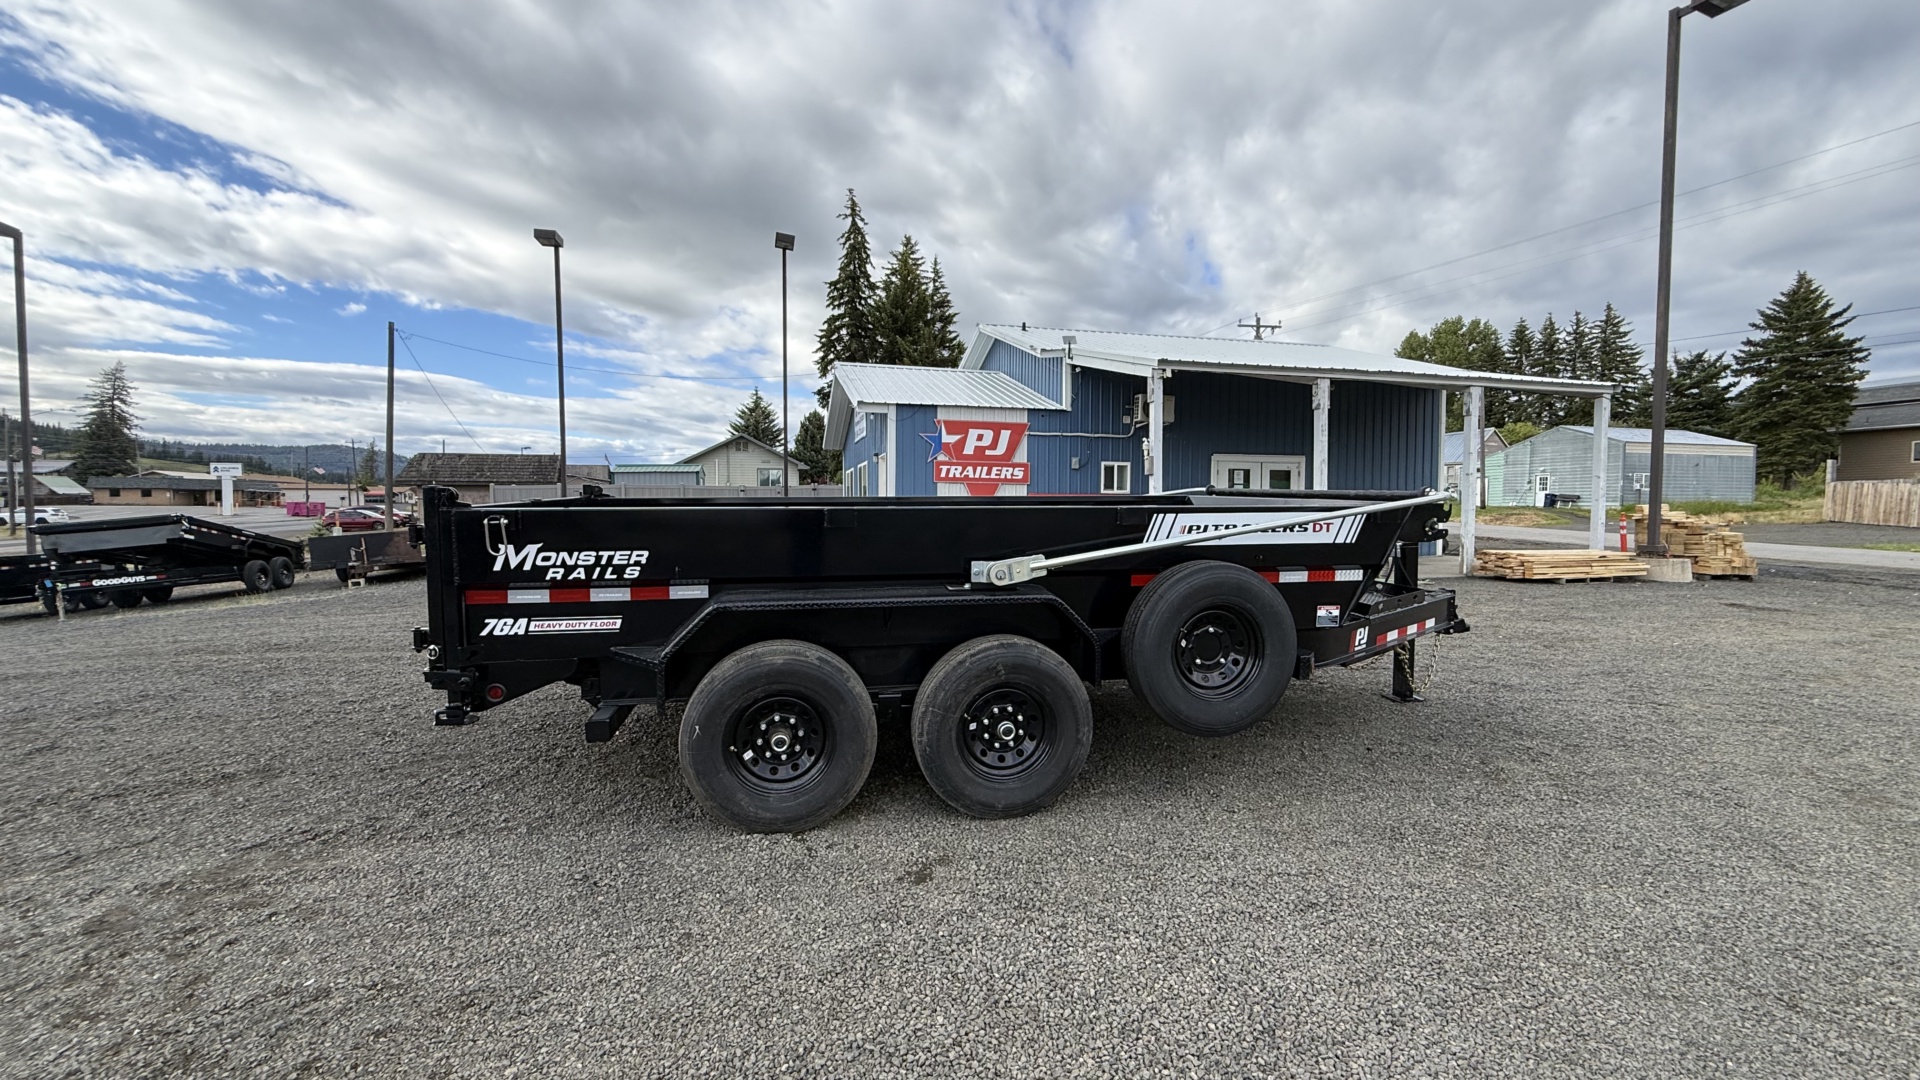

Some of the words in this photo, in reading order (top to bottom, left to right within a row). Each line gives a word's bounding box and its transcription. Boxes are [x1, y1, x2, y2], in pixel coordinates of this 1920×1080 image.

[962, 428, 1011, 456] PJ
[939, 465, 1025, 479] TRAILERS
[1187, 524, 1209, 534] PJ
[1211, 523, 1309, 533] TRERS
[1312, 522, 1335, 533] DT
[493, 542, 649, 571] MONSTER
[545, 566, 641, 580] RAILS
[479, 617, 528, 636] 7GA
[564, 621, 588, 629] DUTY
[589, 620, 618, 628] FLOOR
[1355, 625, 1369, 646] PJ
